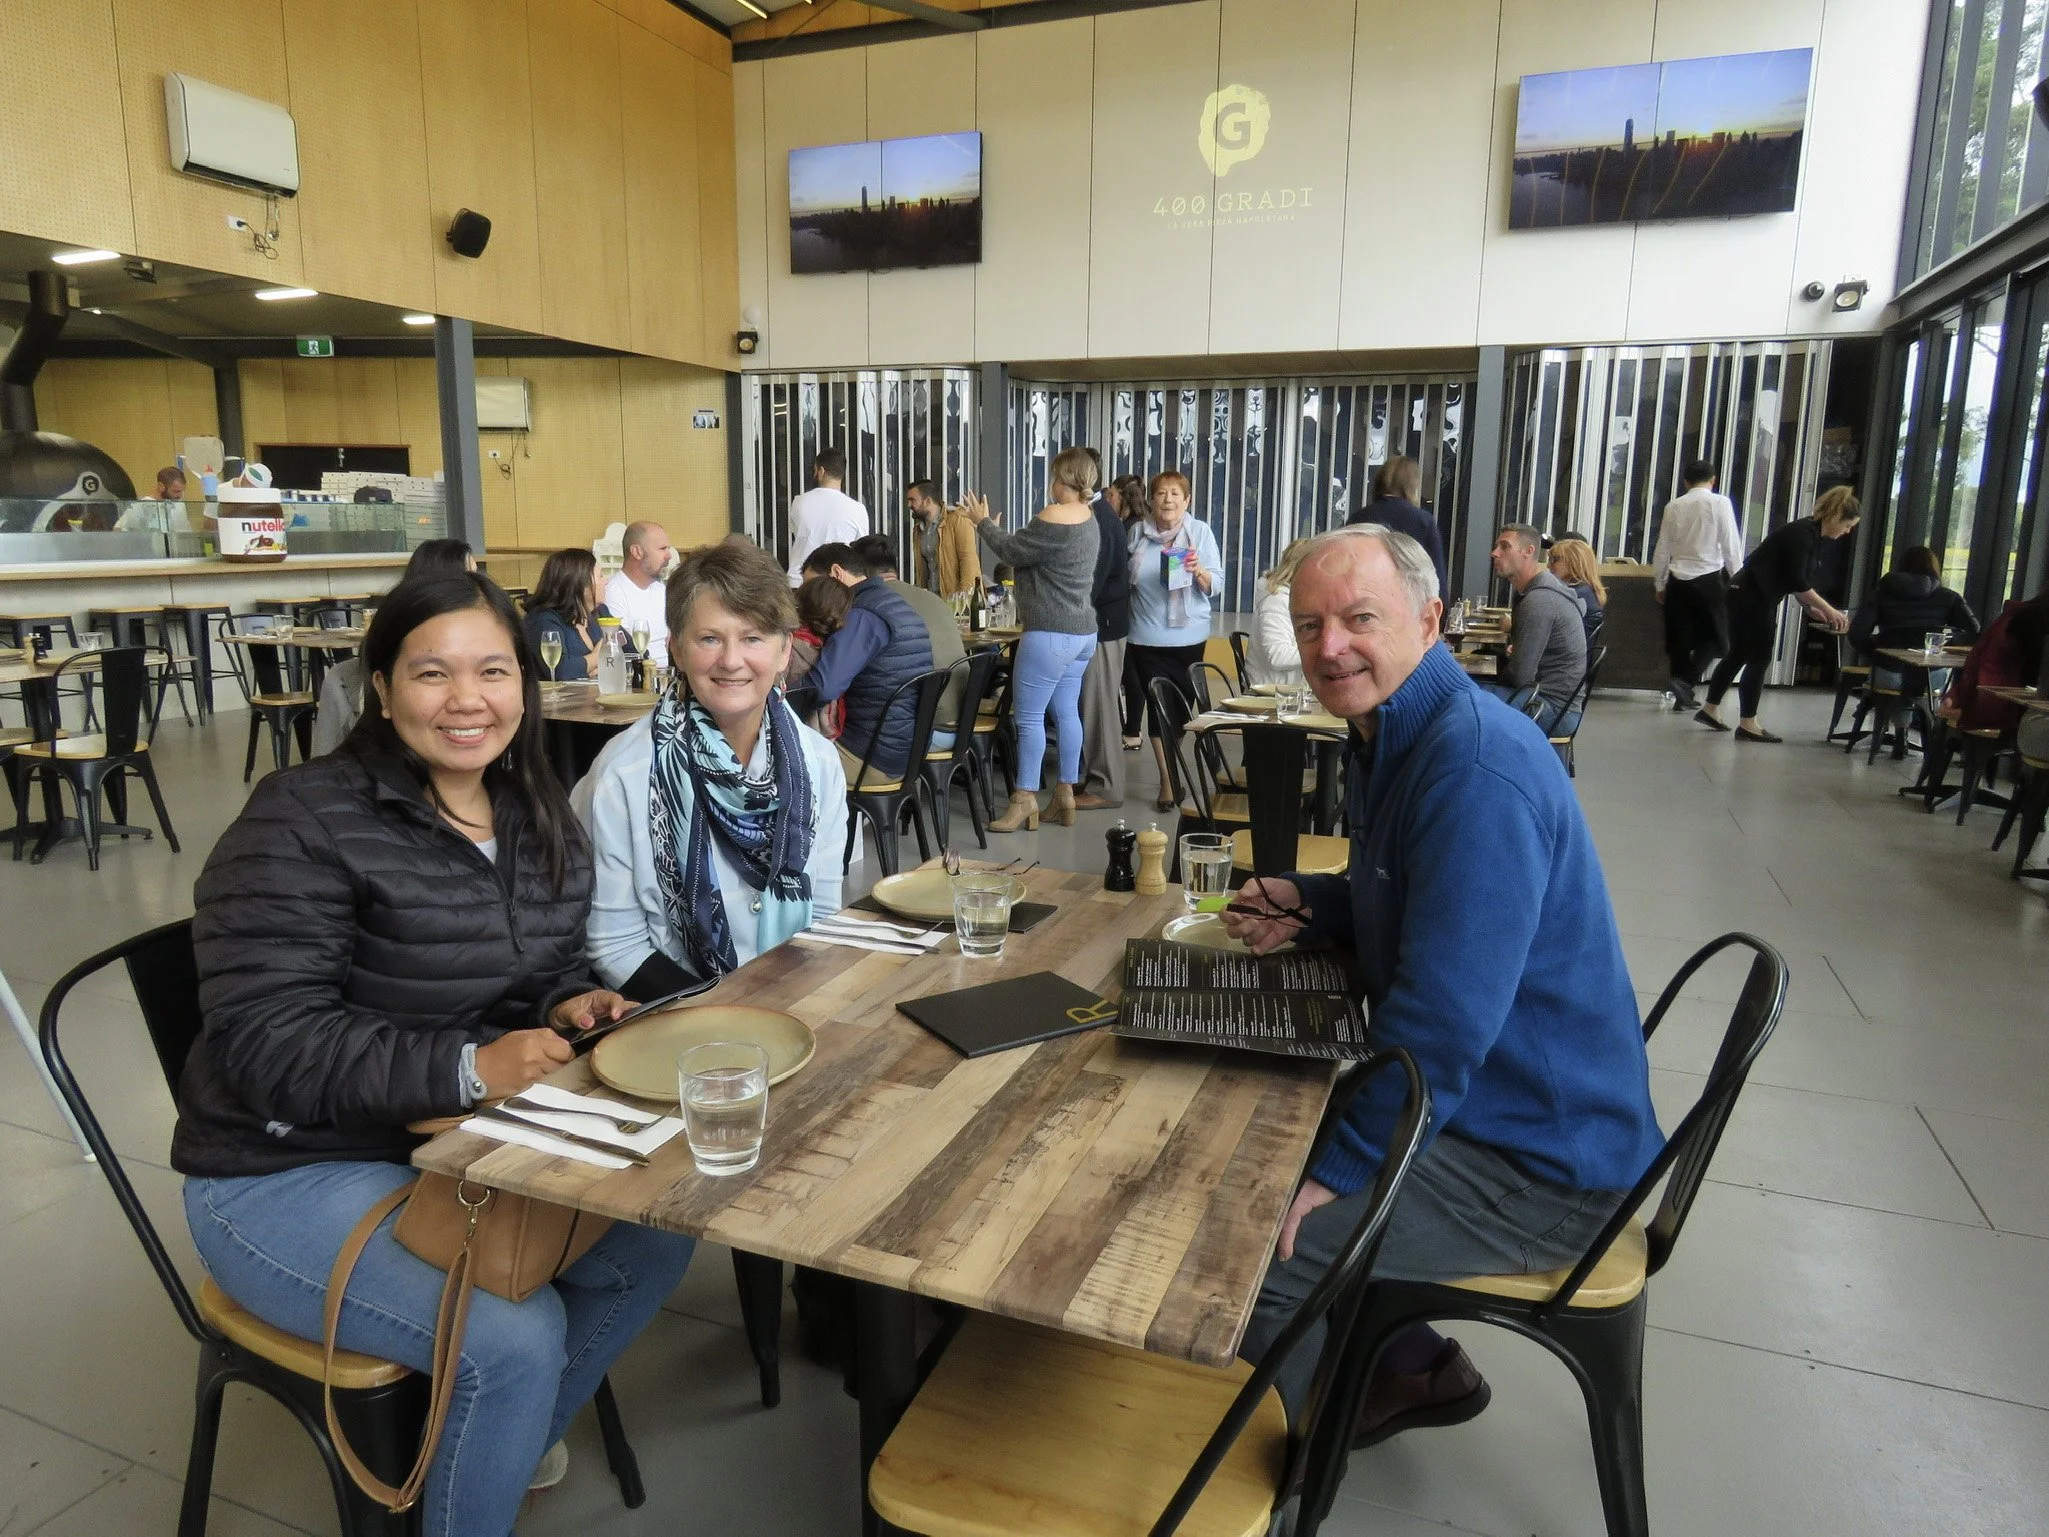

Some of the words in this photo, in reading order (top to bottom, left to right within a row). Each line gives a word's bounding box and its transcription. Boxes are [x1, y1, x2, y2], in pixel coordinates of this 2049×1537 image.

[1212, 102, 1251, 151] G
[1153, 196, 1206, 217] 400
[1217, 187, 1314, 213] GRADI
[86, 480, 96, 490] G
[606, 656, 614, 668] R
[1065, 999, 1119, 1024] R
